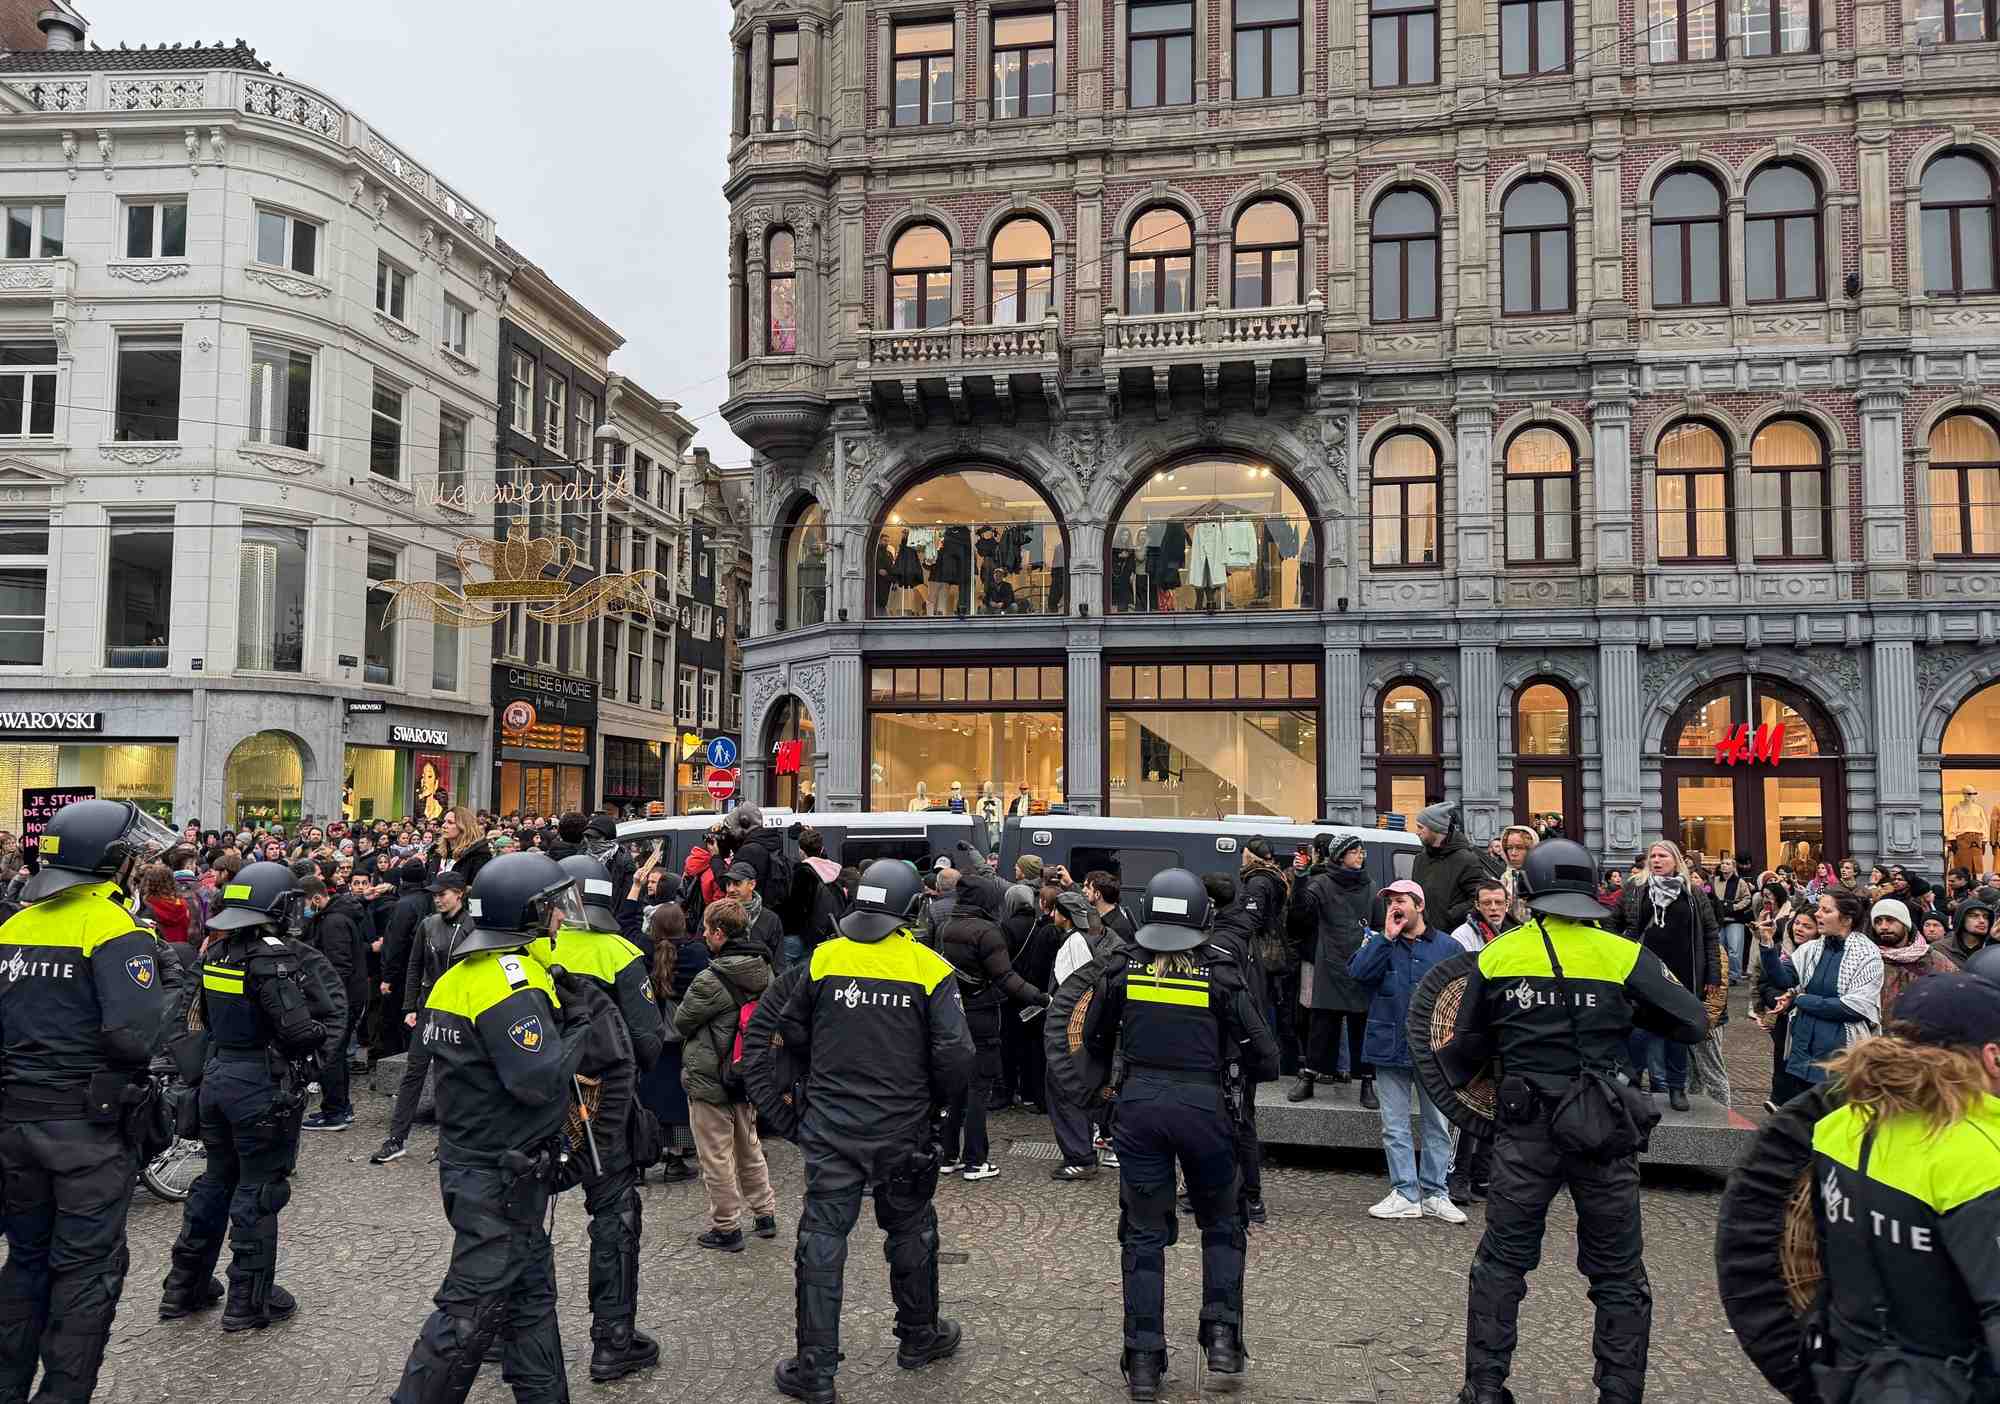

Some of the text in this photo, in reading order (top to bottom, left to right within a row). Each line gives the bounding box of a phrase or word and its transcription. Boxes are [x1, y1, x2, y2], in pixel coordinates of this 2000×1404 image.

[416, 469, 633, 510] Nieuwendijk
[393, 726, 448, 745] SWAROVSKI
[1714, 721, 1785, 767] H&M
[24, 808, 39, 817] DE
[31, 796, 46, 806] JE
[834, 982, 911, 1008] POLITIE
[1506, 982, 1596, 1009] POLIIE
